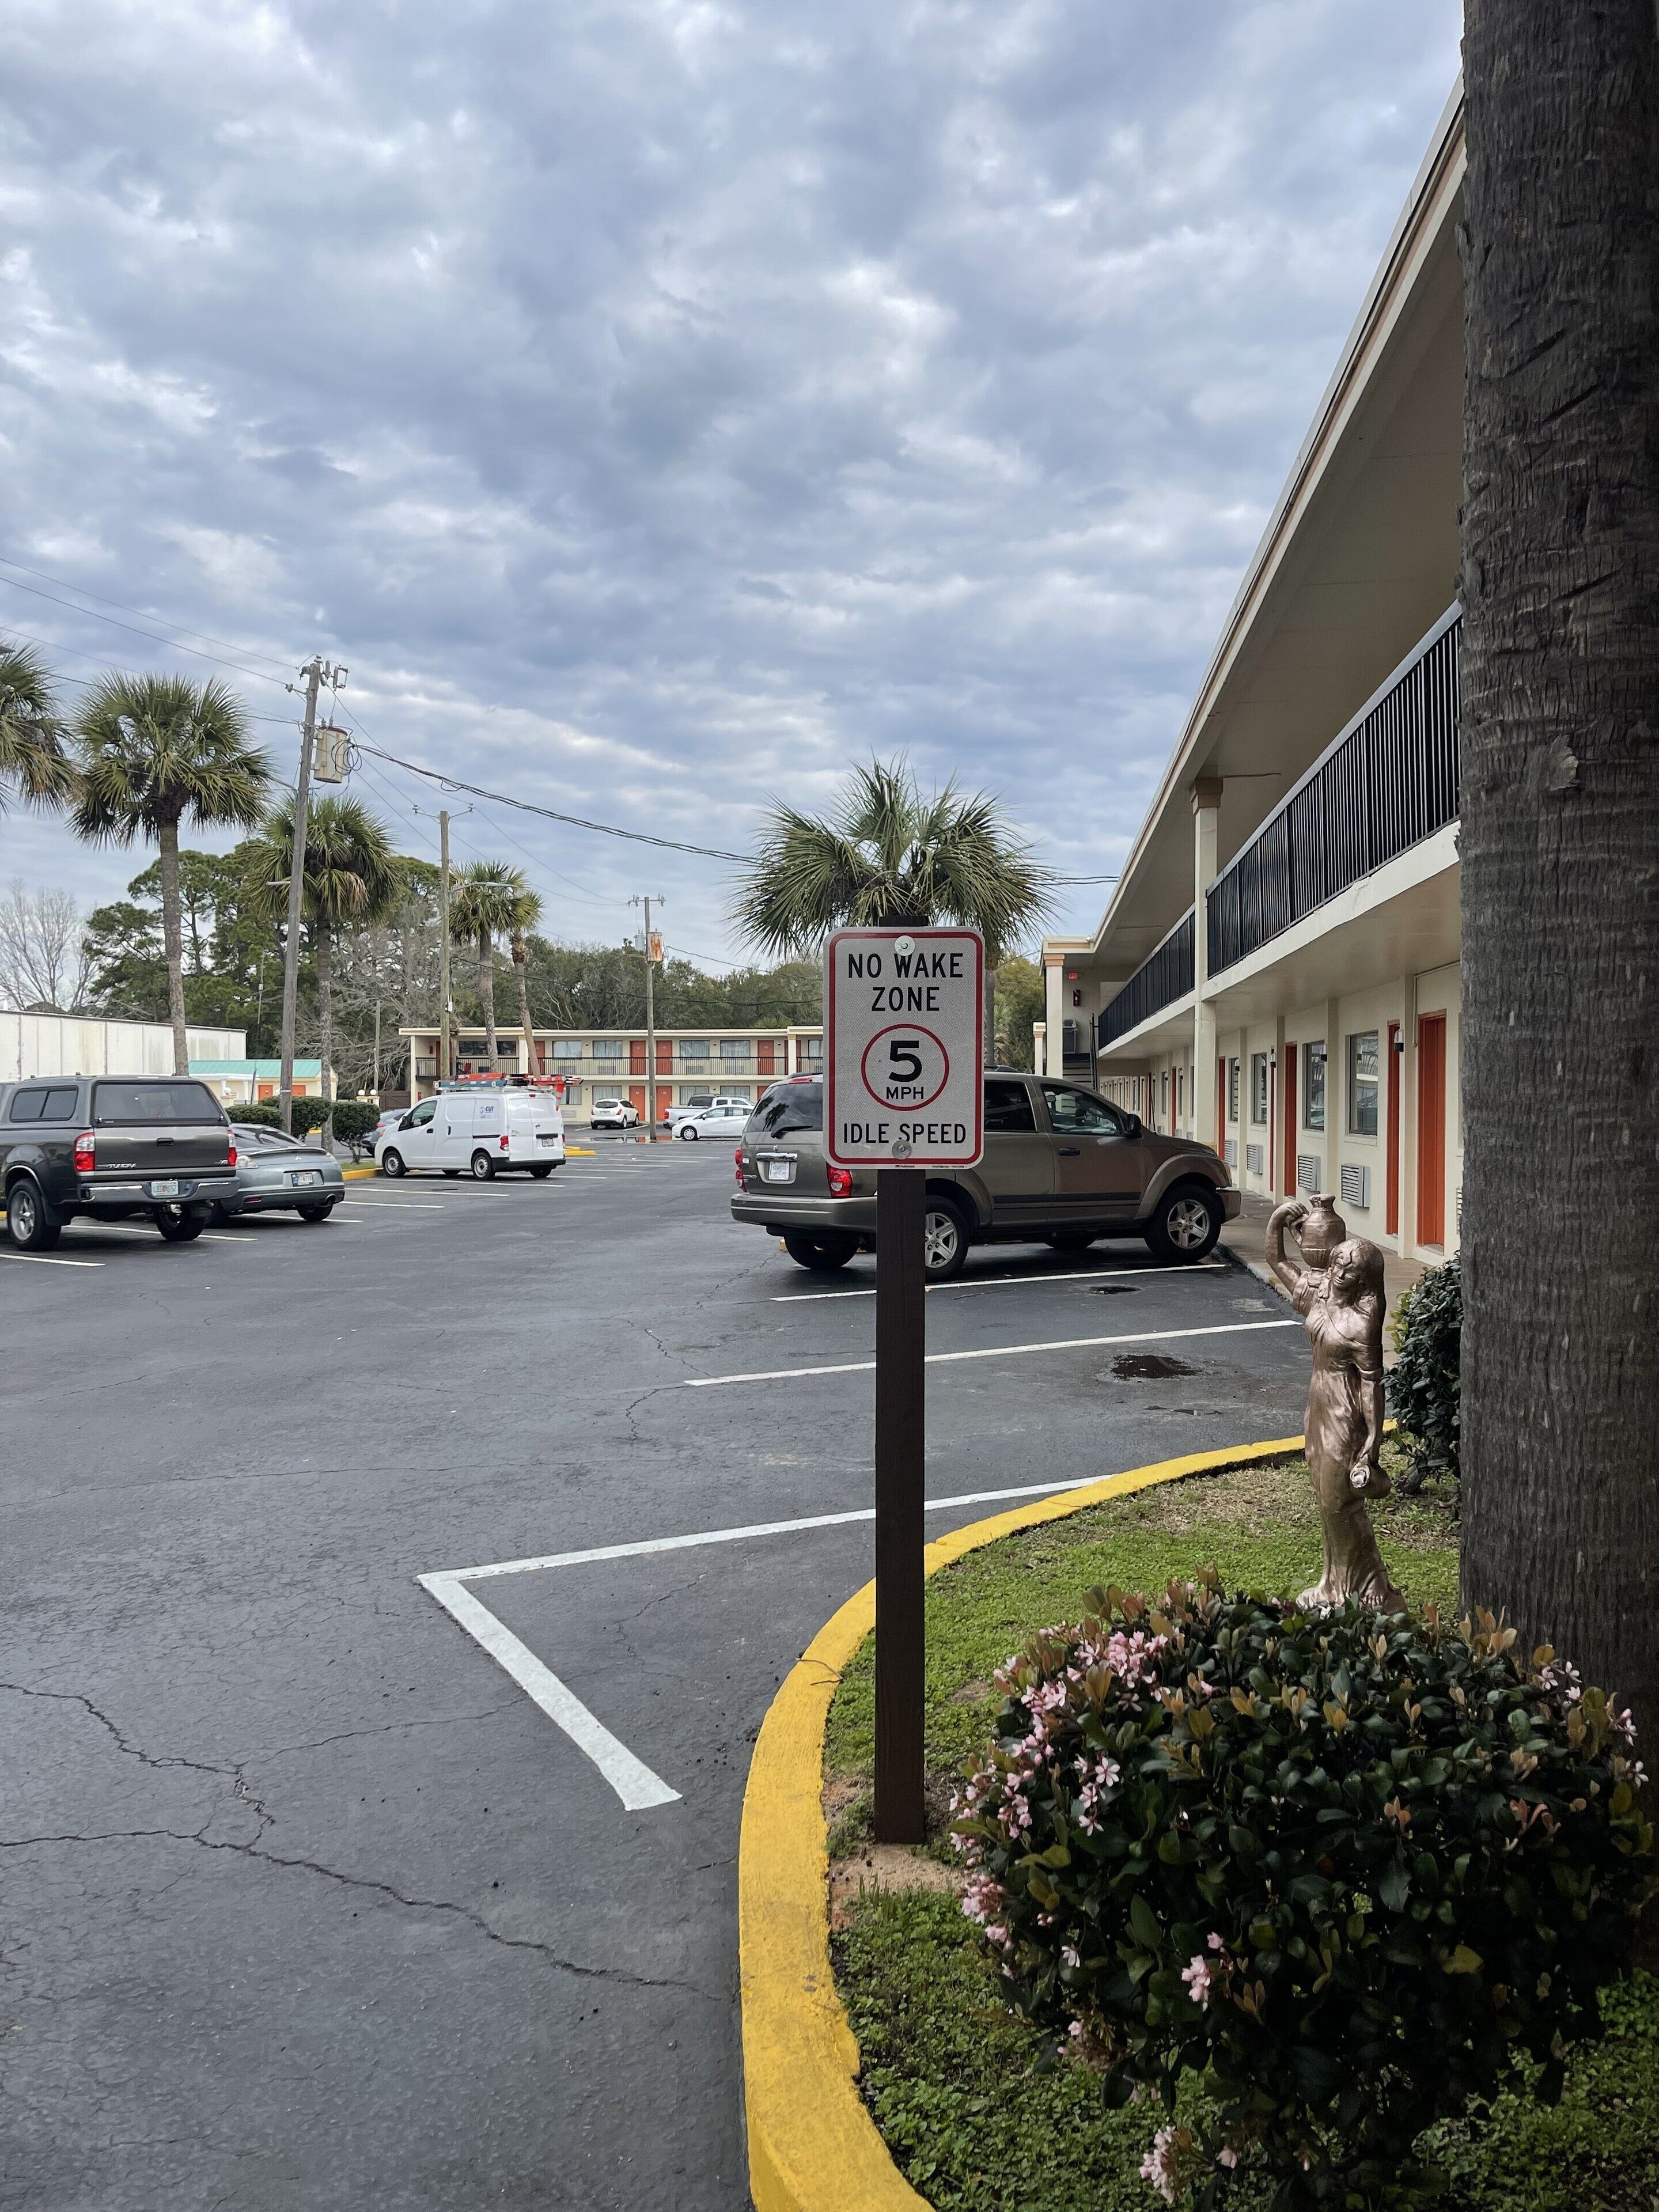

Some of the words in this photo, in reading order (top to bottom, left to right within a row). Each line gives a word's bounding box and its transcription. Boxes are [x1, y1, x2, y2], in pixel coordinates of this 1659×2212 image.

[848, 953, 882, 978] NO
[894, 953, 964, 978] WAKE
[871, 987, 940, 1012] ZONE
[888, 1040, 923, 1082] 5
[885, 1086, 924, 1100] MPH
[843, 1123, 889, 1144] IDLE
[899, 1123, 967, 1144] SPEED
